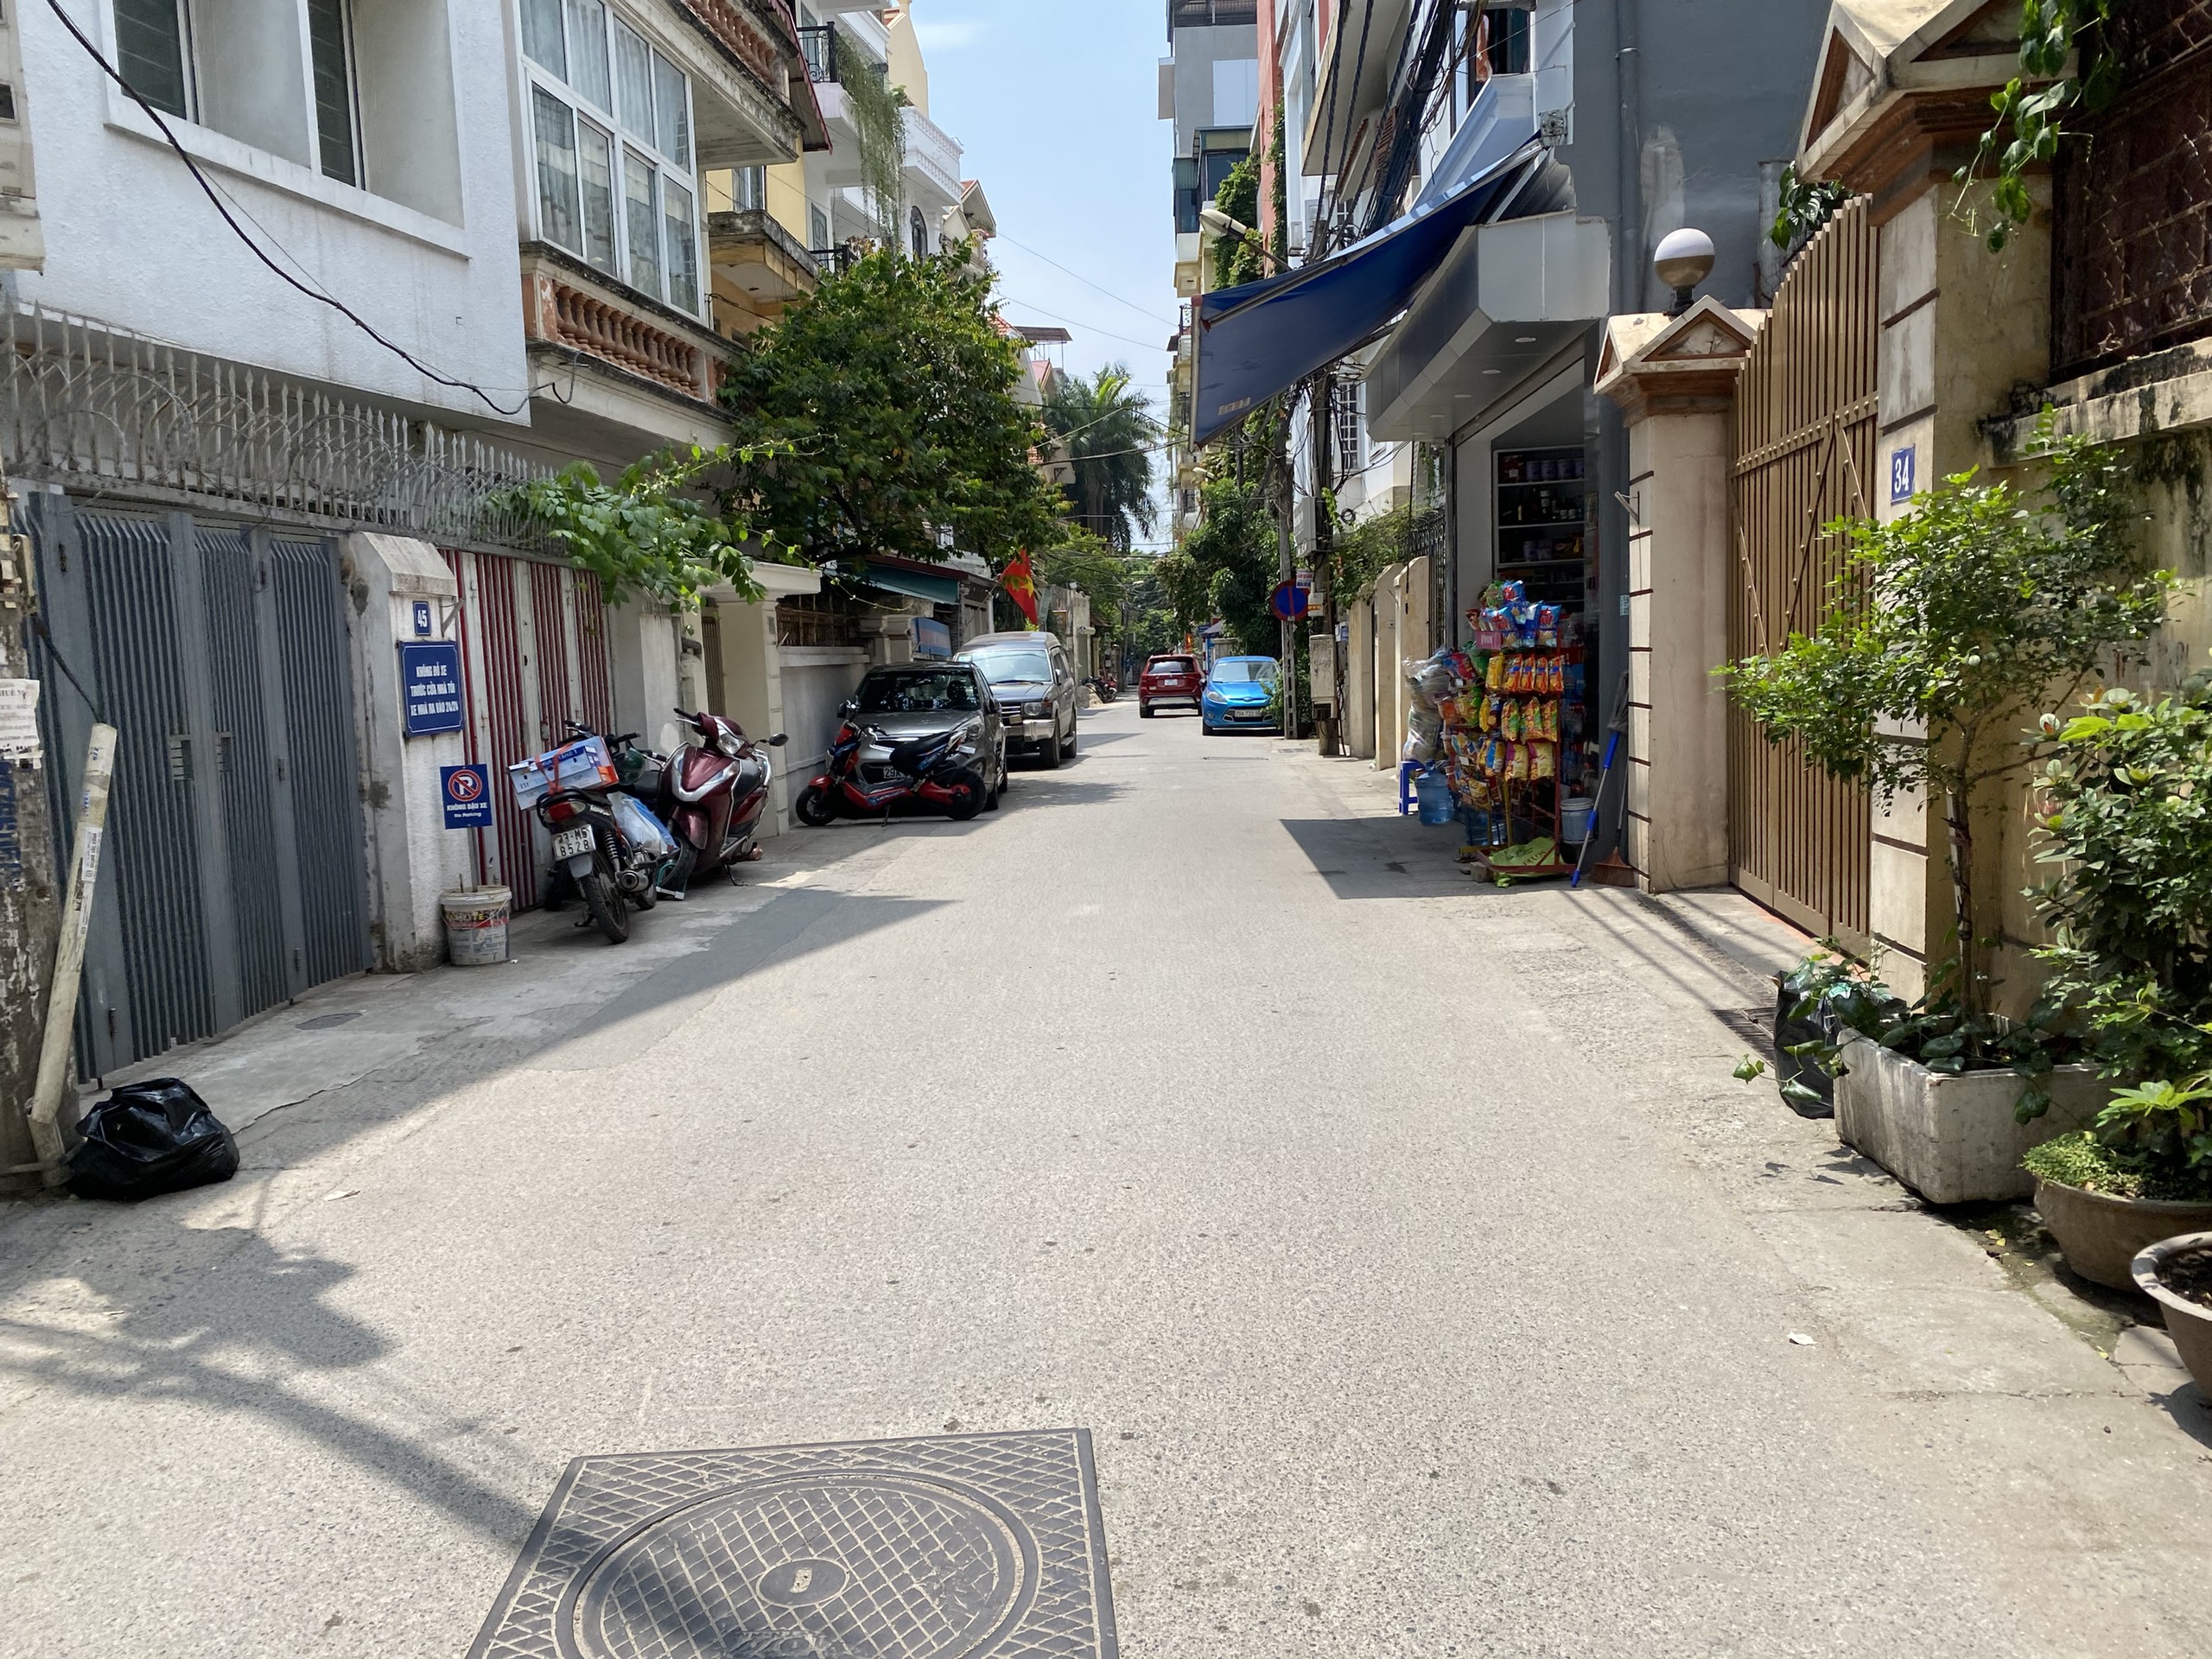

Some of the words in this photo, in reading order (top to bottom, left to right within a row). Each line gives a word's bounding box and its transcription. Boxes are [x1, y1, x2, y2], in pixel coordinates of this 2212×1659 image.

[1894, 455, 1910, 493] 34
[417, 609, 428, 628] 45
[416, 664, 433, 678] KHÔNG
[440, 664, 448, 677] XE
[436, 681, 448, 695] NHÀ
[410, 704, 417, 716] XE
[417, 701, 429, 715] NHÀ
[428, 702, 436, 715] RA
[435, 700, 446, 714] VÀO
[447, 803, 467, 811] KHÔNG
[467, 802, 480, 811] ĐẬU
[560, 839, 589, 856] 8528
